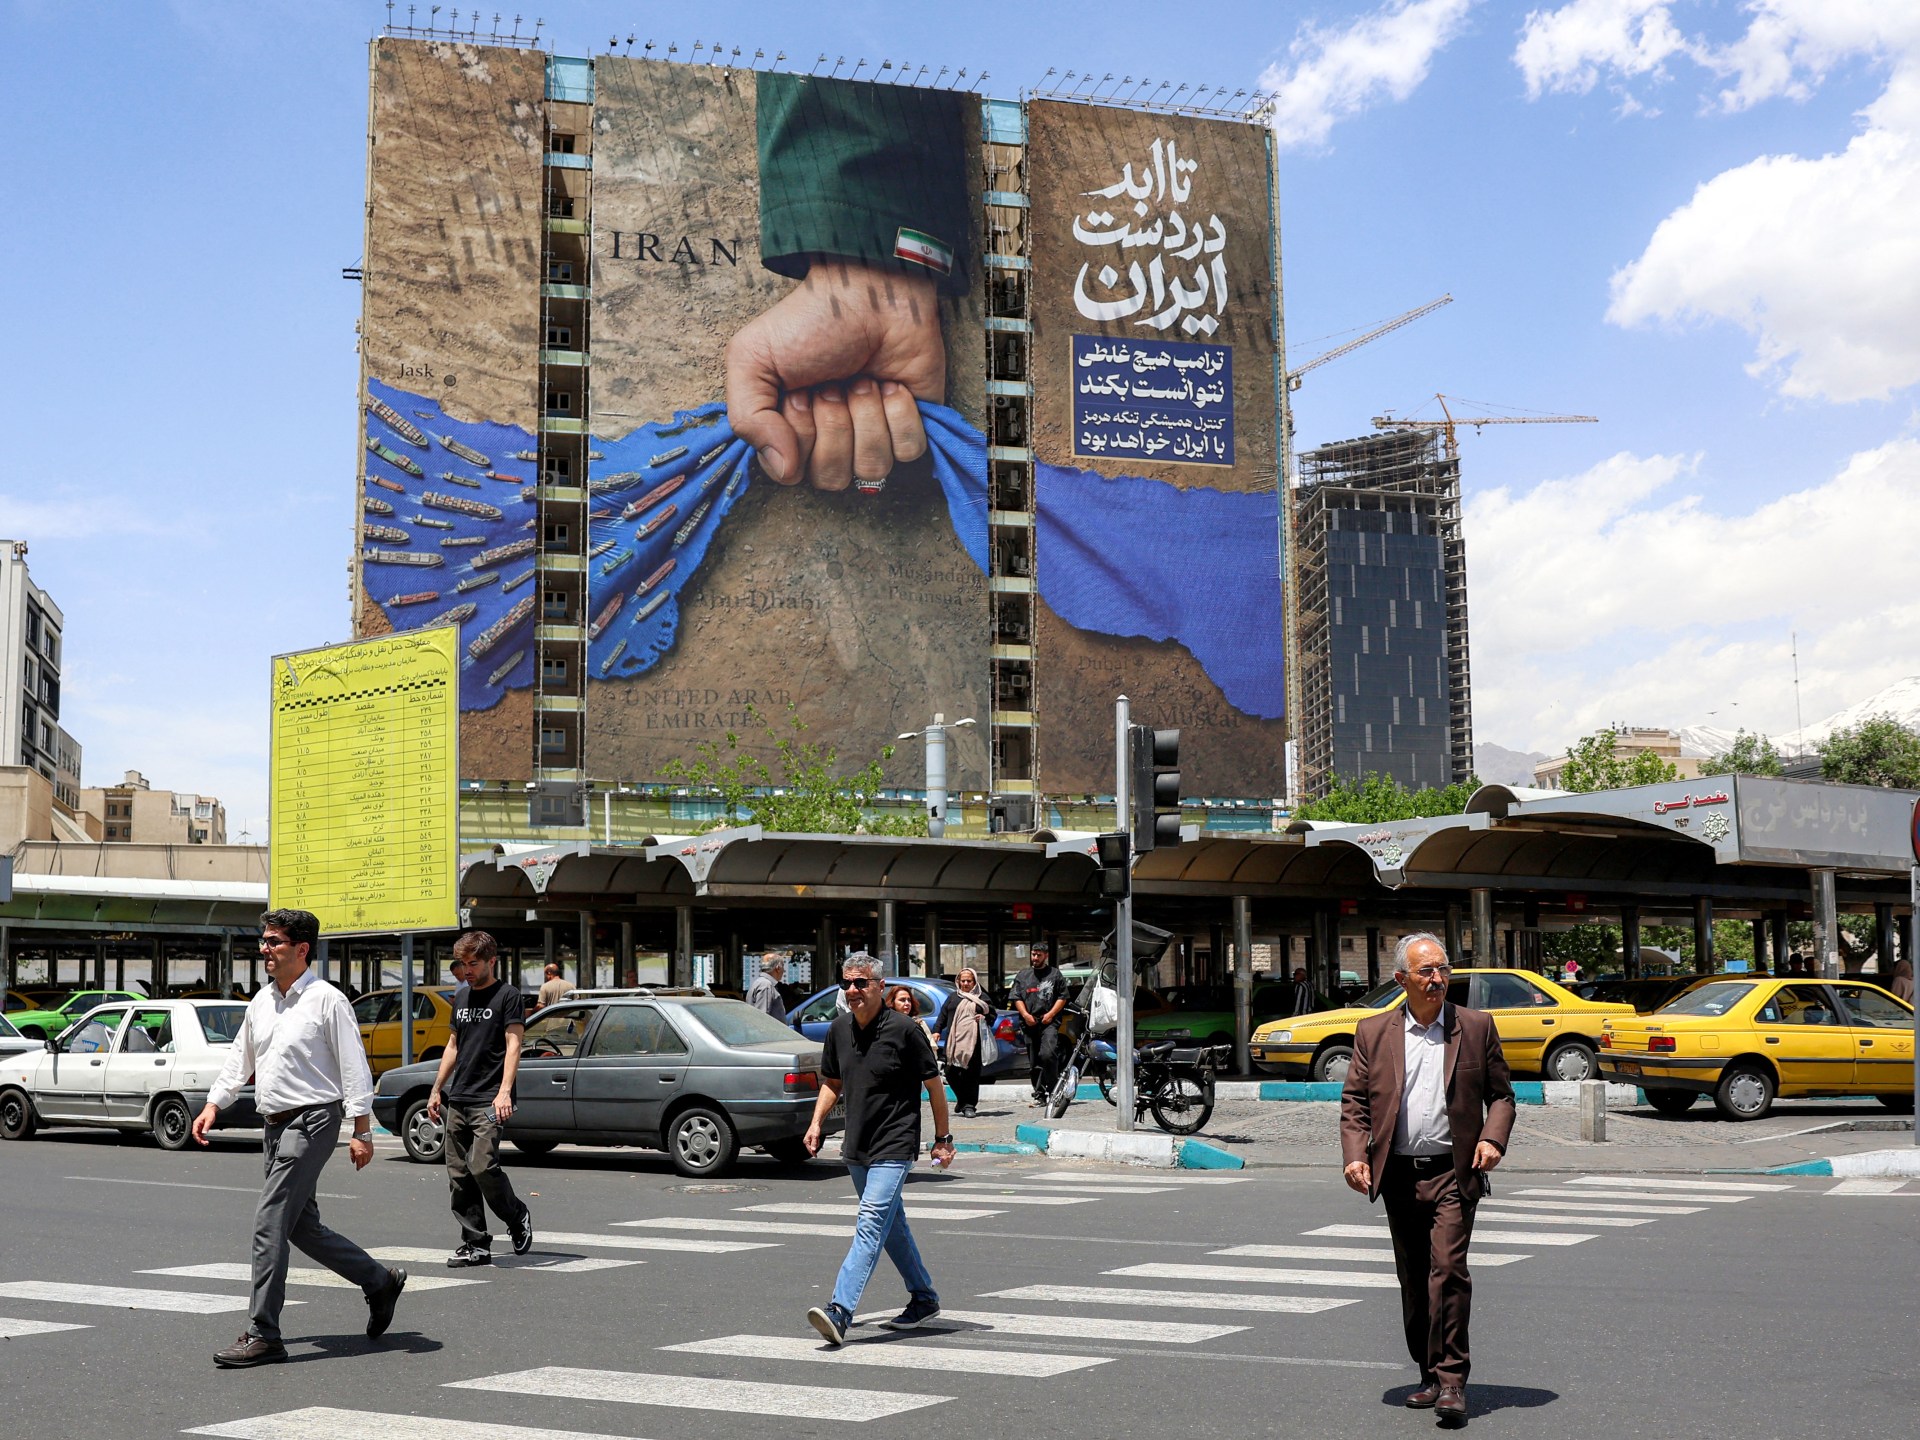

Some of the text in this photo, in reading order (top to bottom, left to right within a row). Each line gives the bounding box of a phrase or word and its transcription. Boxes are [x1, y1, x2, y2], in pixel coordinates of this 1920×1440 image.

[1078, 137, 1198, 218] تا ابد
[1072, 210, 1227, 261] در دست
[609, 230, 739, 267] IRAN
[1073, 252, 1229, 337] ایران
[1078, 341, 1225, 376] ترامپ هیچ غلطی
[396, 363, 434, 379] Jask
[1079, 373, 1225, 409] نتوانست بکند
[1080, 410, 1226, 432] کنترل همیشگی تنگه هرمز
[1080, 429, 1226, 460] با ایران خواهد بود
[1079, 655, 1128, 670] Dubai
[290, 691, 315, 700] TERMINAL
[409, 694, 421, 703] خط
[422, 691, 444, 703] شماره
[626, 689, 792, 706] UNITED ARAB
[313, 708, 328, 720] طول
[355, 703, 375, 711] مقصد
[296, 714, 313, 723] مسیر
[646, 712, 768, 729] EMIRATES
[1155, 705, 1242, 728] Muscat
[1654, 790, 1728, 812] مقصد کرج
[457, 1008, 493, 1020] KENZO
